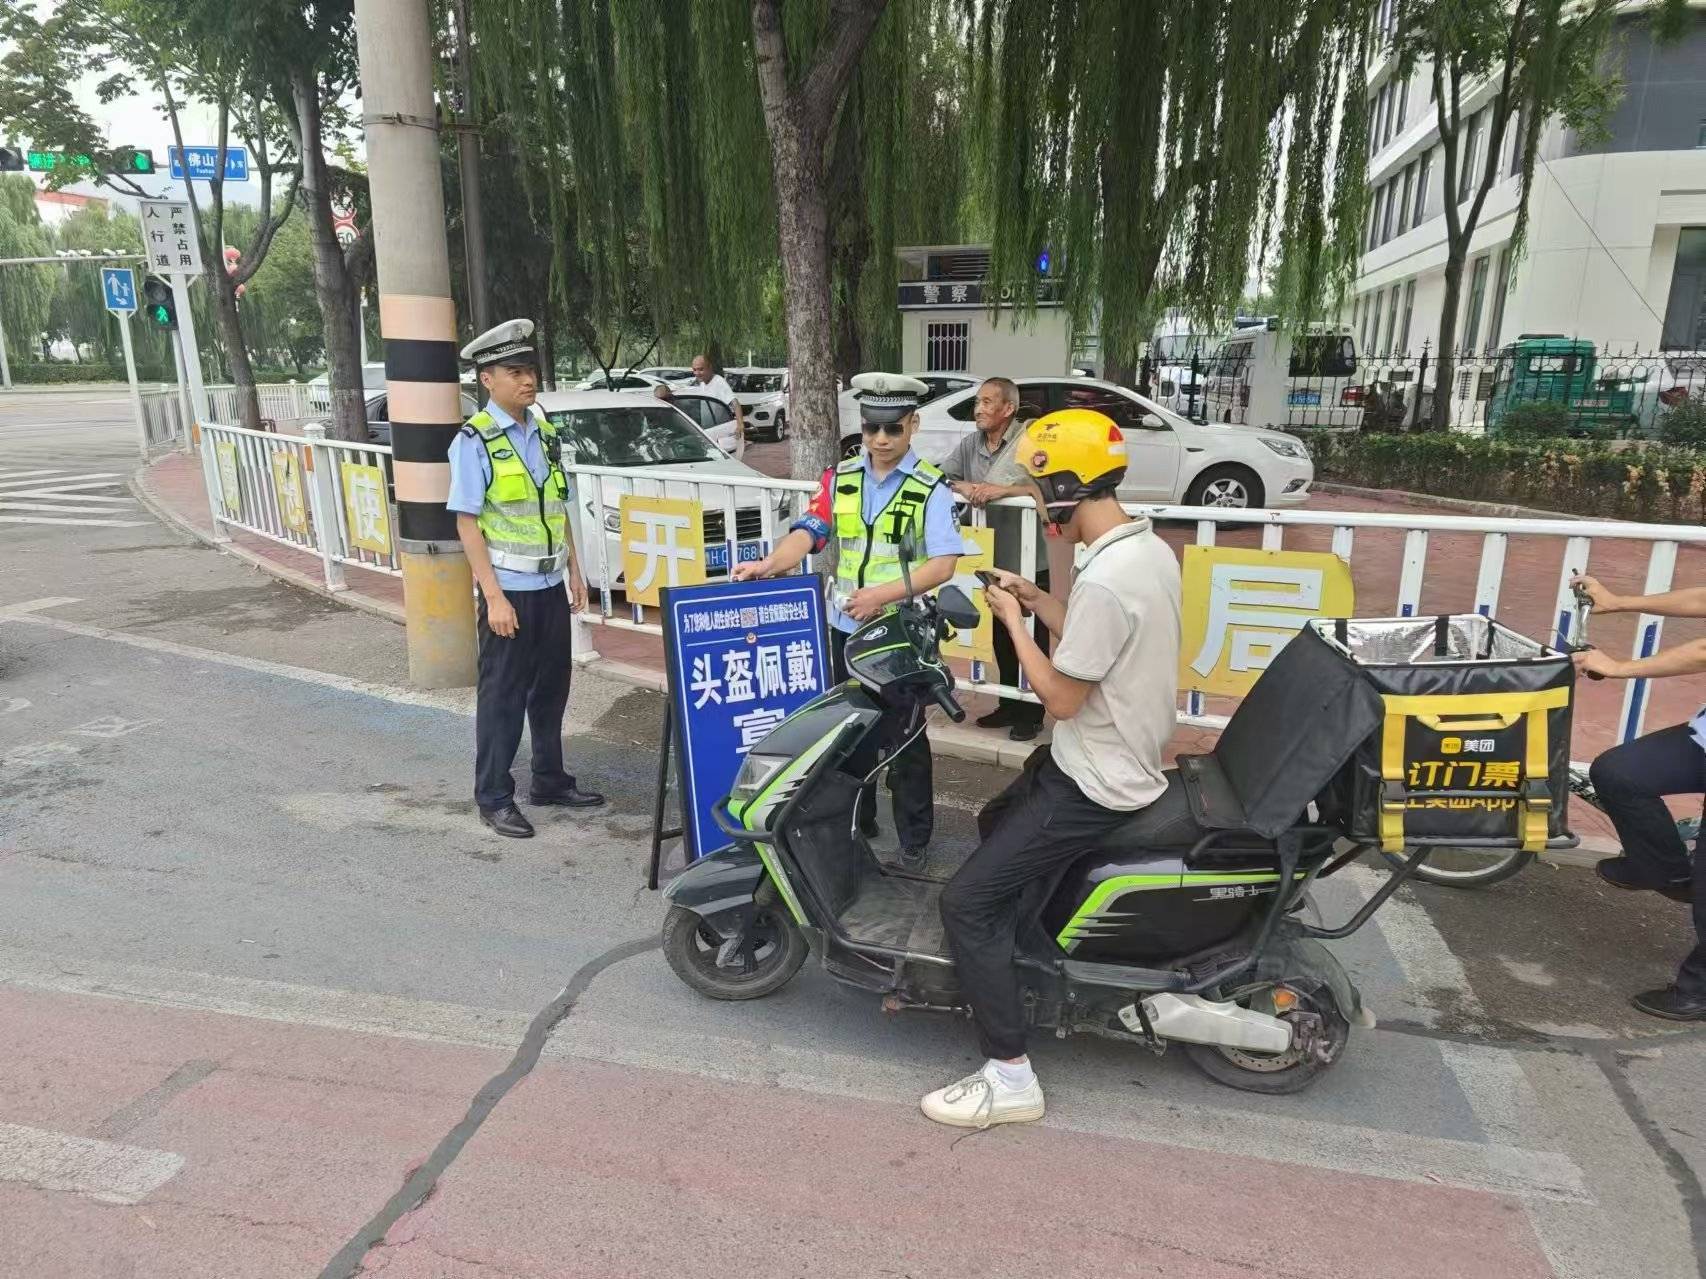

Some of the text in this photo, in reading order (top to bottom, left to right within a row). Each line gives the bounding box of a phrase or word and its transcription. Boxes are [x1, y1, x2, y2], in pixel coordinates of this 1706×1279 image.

[147, 206, 171, 267] 人行道
[169, 206, 193, 267] 严禁占用
[923, 285, 968, 304] 警察
[628, 510, 696, 593] 开
[1188, 563, 1323, 679] 启
[690, 639, 817, 710] 头盔佩戴
[1408, 761, 1521, 787] 订门票
[1463, 739, 1495, 752] 美团
